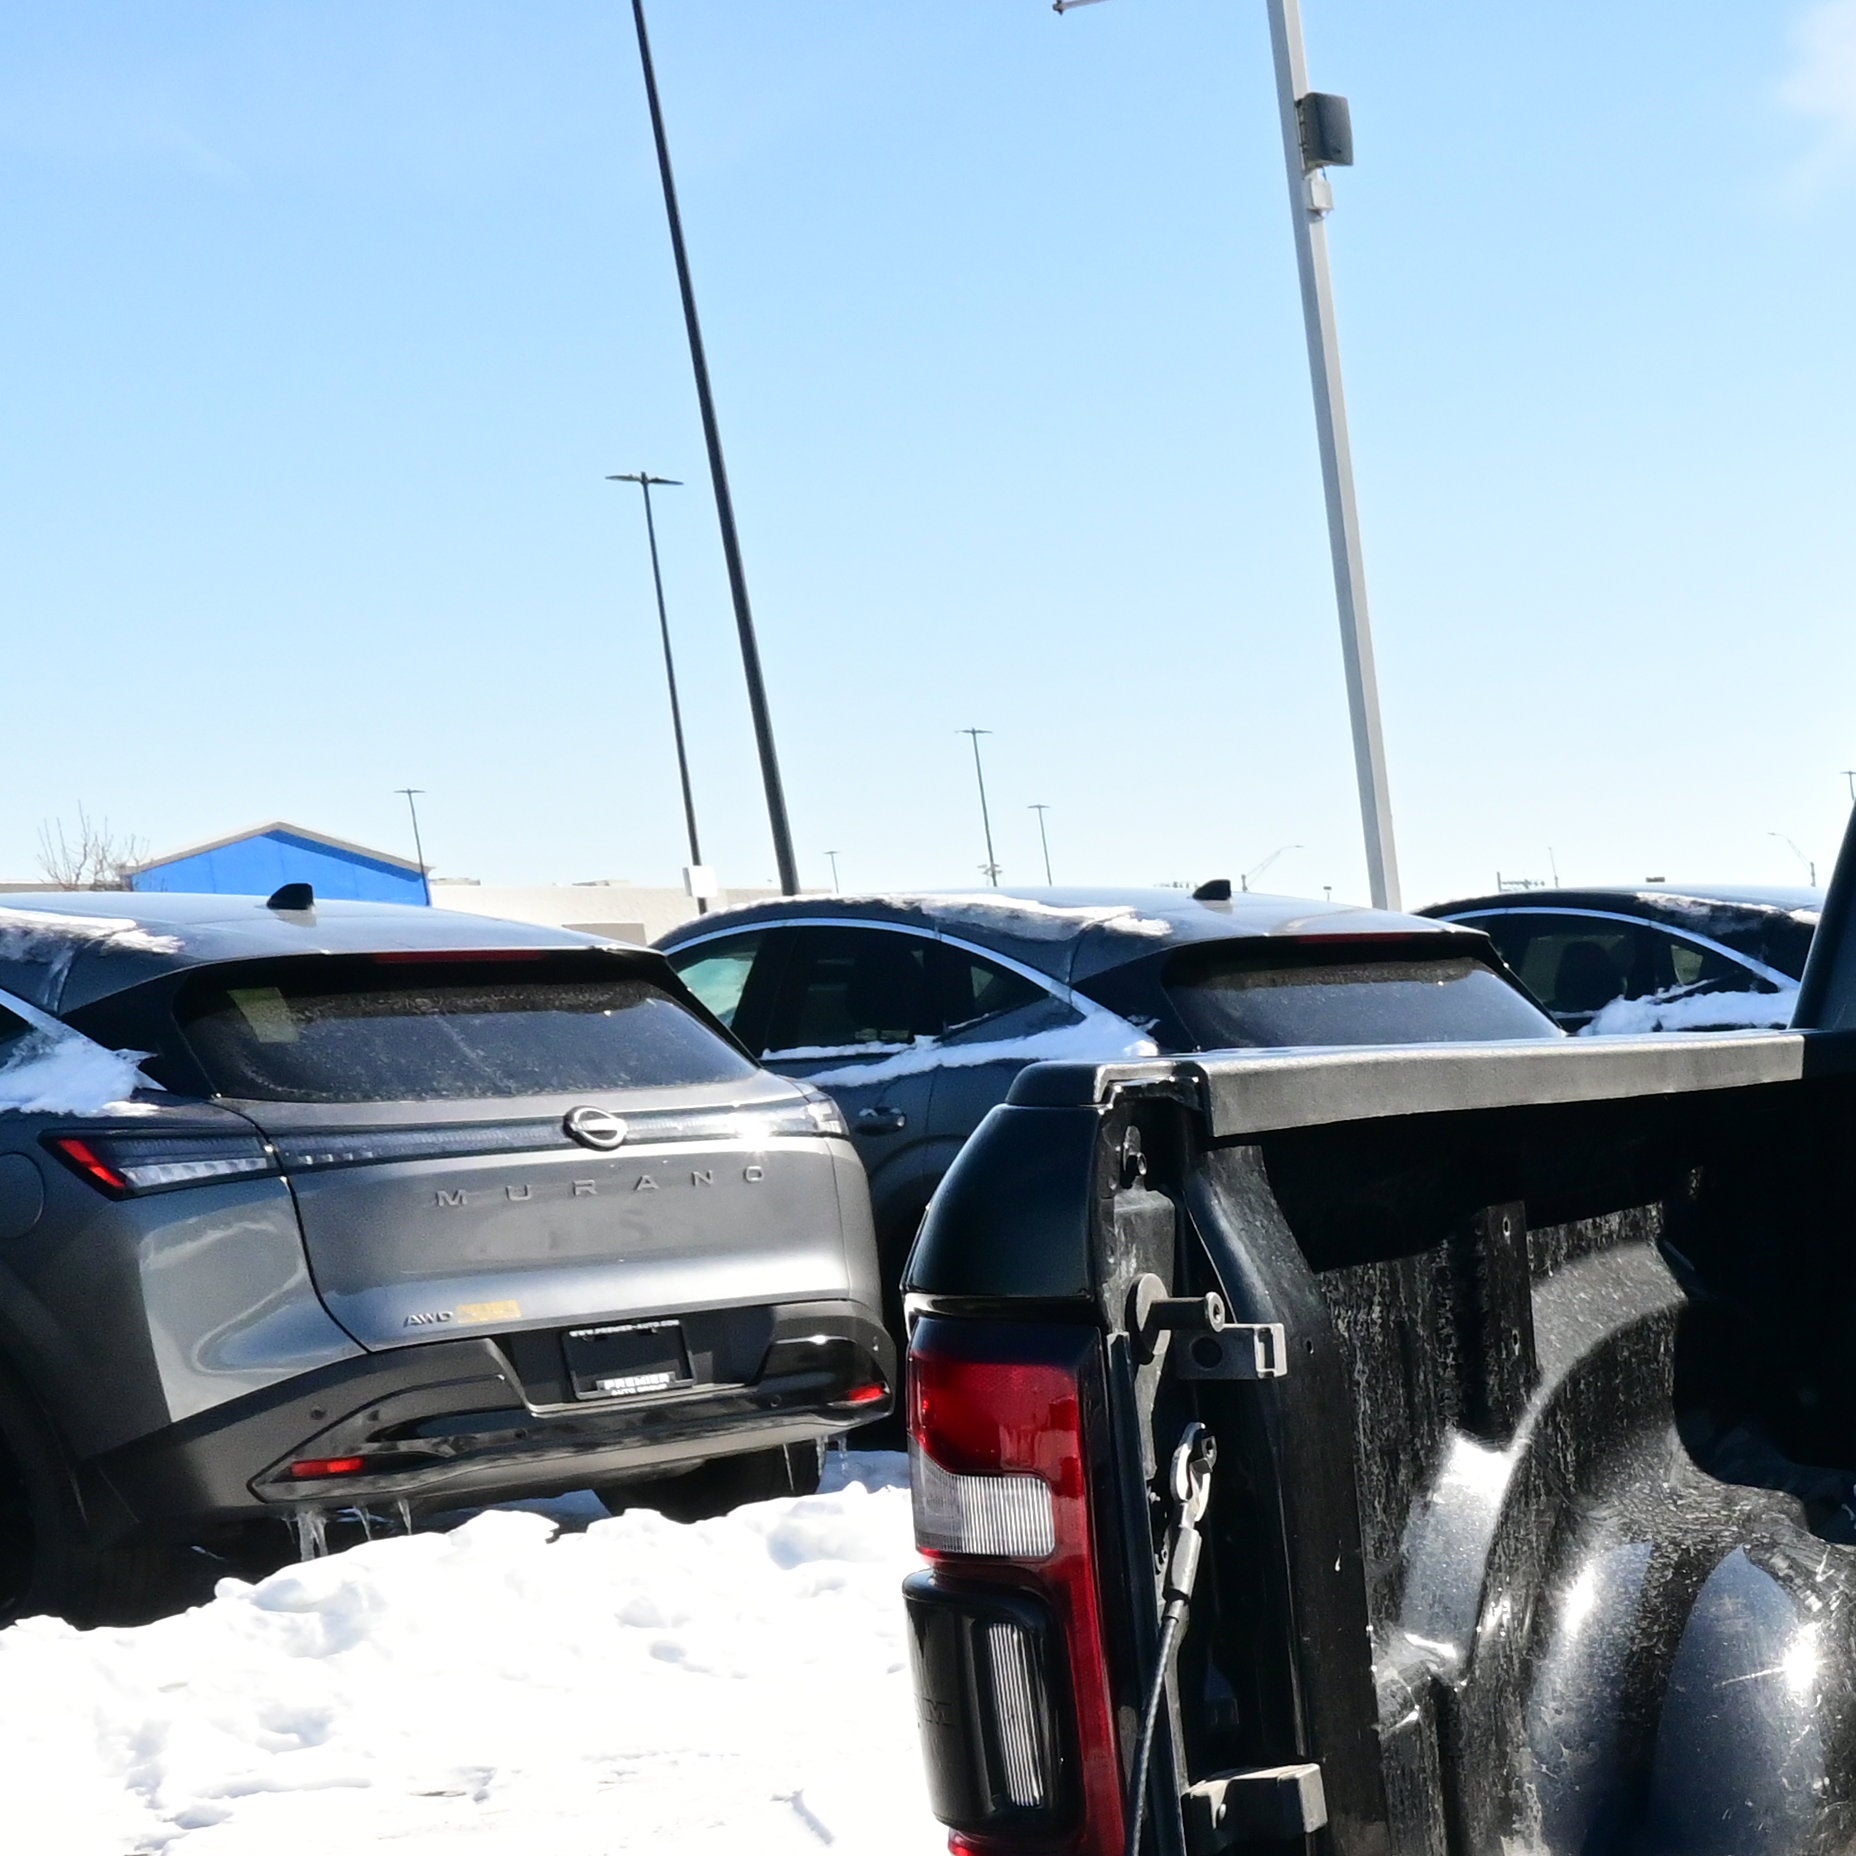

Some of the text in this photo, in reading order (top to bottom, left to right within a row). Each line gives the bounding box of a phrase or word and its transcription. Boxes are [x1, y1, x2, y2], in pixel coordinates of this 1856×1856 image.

[435, 1165, 765, 1207] MURANO
[403, 1311, 454, 1328] AWD
[604, 1373, 670, 1390] PREMIER
